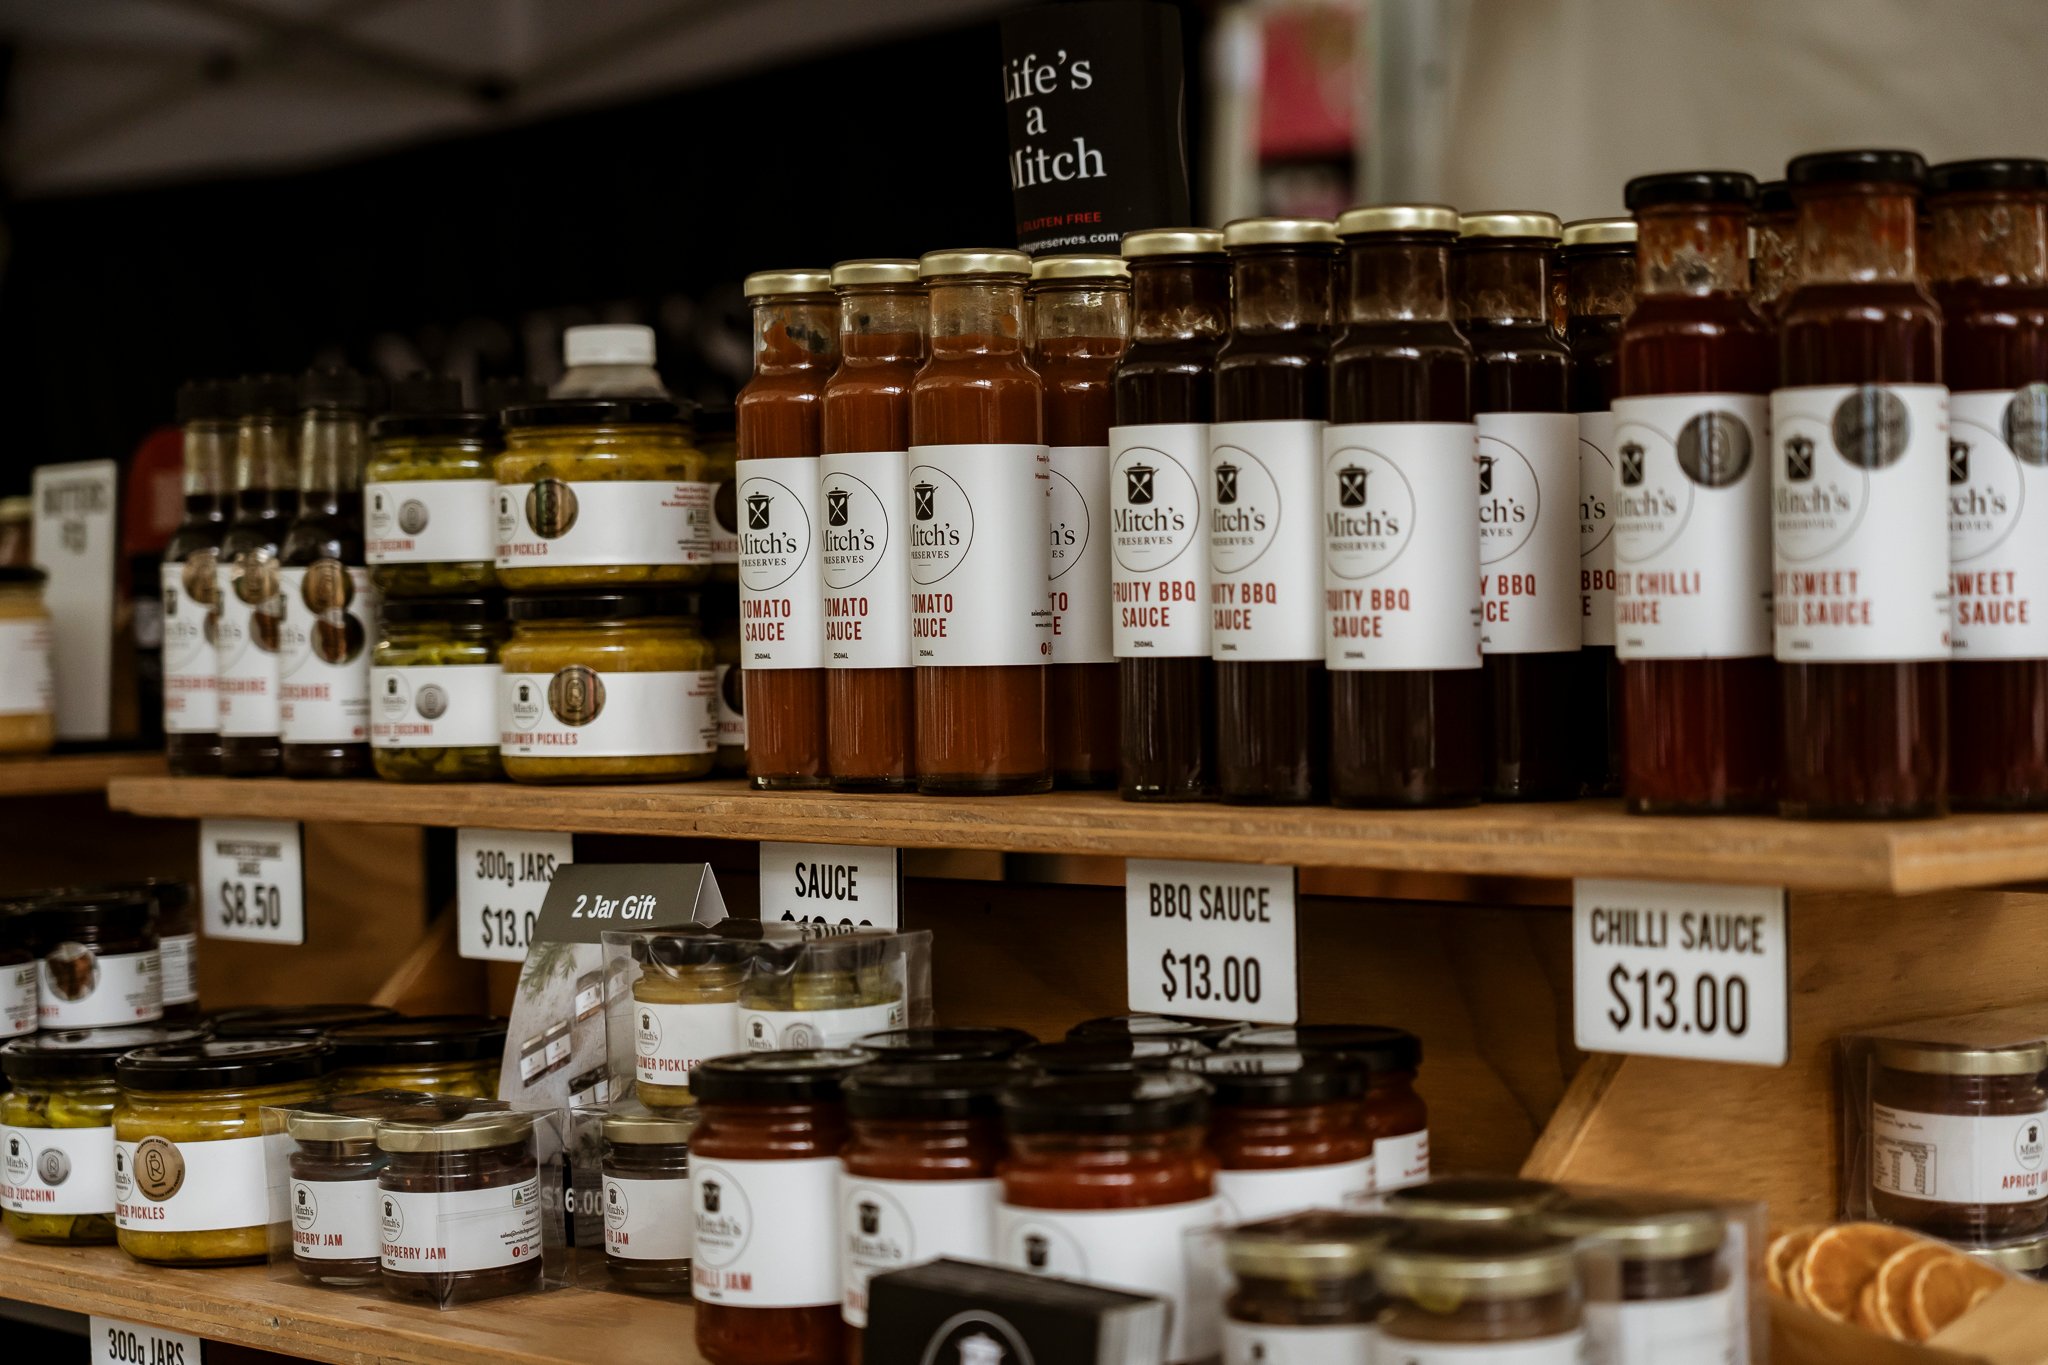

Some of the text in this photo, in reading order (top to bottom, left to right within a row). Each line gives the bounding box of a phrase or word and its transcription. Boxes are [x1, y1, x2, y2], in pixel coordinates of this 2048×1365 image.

[1025, 106, 1047, 136] a
[1067, 211, 1102, 225] FREE
[1114, 506, 1184, 533] Mitch's
[1479, 498, 1525, 523] ch's
[1117, 536, 1173, 546] PRESERVES
[742, 558, 787, 568] PRESERVES
[824, 555, 864, 565] PRESERVES
[1113, 580, 1196, 602] FRUITY BBQ
[1498, 574, 1536, 597] BBQ
[1581, 569, 1616, 591] BBQ
[1636, 571, 1700, 596] CHILLI
[1791, 570, 1857, 596] SWEET
[1242, 582, 1277, 605] BBQ
[1371, 588, 1410, 611] BBQ
[742, 599, 791, 619] TOMATO
[824, 597, 868, 618] TOMATO
[1122, 606, 1170, 628] SAUCE
[1804, 600, 1871, 625] SAUCE
[1958, 600, 2029, 625] SAUCE
[745, 622, 785, 642] SAUCE
[826, 621, 862, 641] SAUCE
[913, 617, 947, 638] SAUCE
[1333, 616, 1382, 638] SAUCE
[537, 733, 578, 745] PICKLES
[476, 851, 556, 887] 300g JARS
[795, 862, 858, 901] SAUCE
[220, 879, 281, 929] $8.50
[571, 894, 657, 920] 2 Jar Gift
[1149, 883, 1270, 923] BBQ SAUCE
[481, 905, 537, 948] $13.0
[1591, 907, 1765, 954] CHILLI SAUCE
[1161, 949, 1261, 1004] $13.00
[1608, 962, 1748, 1037] $13.00
[2002, 1172, 2039, 1189] APRICOT
[16, 1187, 56, 1202] ZUCCHINI
[131, 1206, 165, 1220] PICKLES
[324, 1234, 343, 1246] JAM
[615, 1231, 629, 1245] JAM
[425, 1247, 446, 1260] JAM
[725, 1272, 752, 1292] JAM
[108, 1328, 185, 1365] 300g JARS
